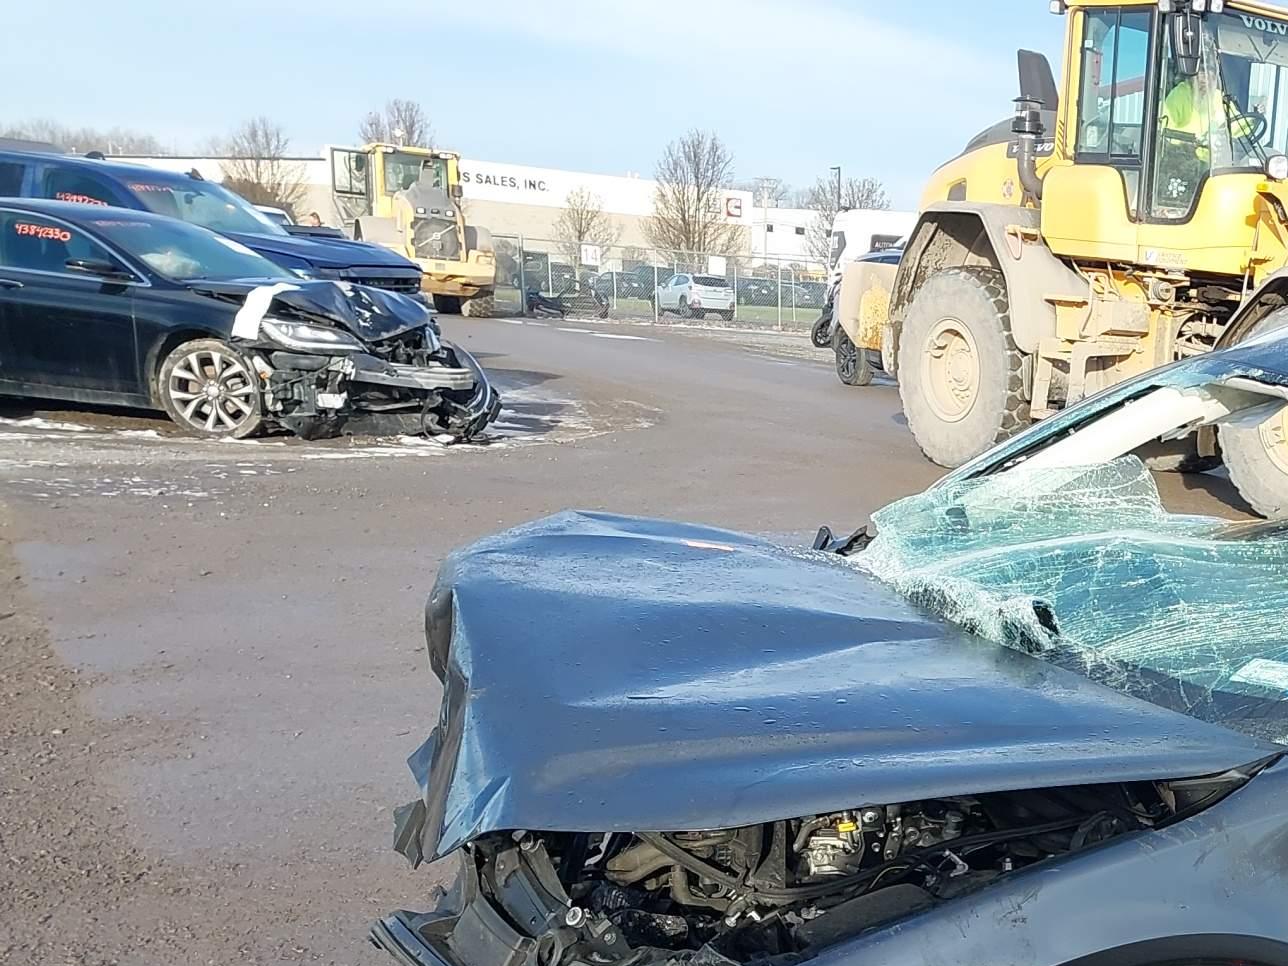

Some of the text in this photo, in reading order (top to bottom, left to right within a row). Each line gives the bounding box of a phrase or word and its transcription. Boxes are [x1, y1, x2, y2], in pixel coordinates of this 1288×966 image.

[475, 173, 520, 189] SALES,
[524, 179, 550, 192] INC.
[583, 247, 598, 262] 14
